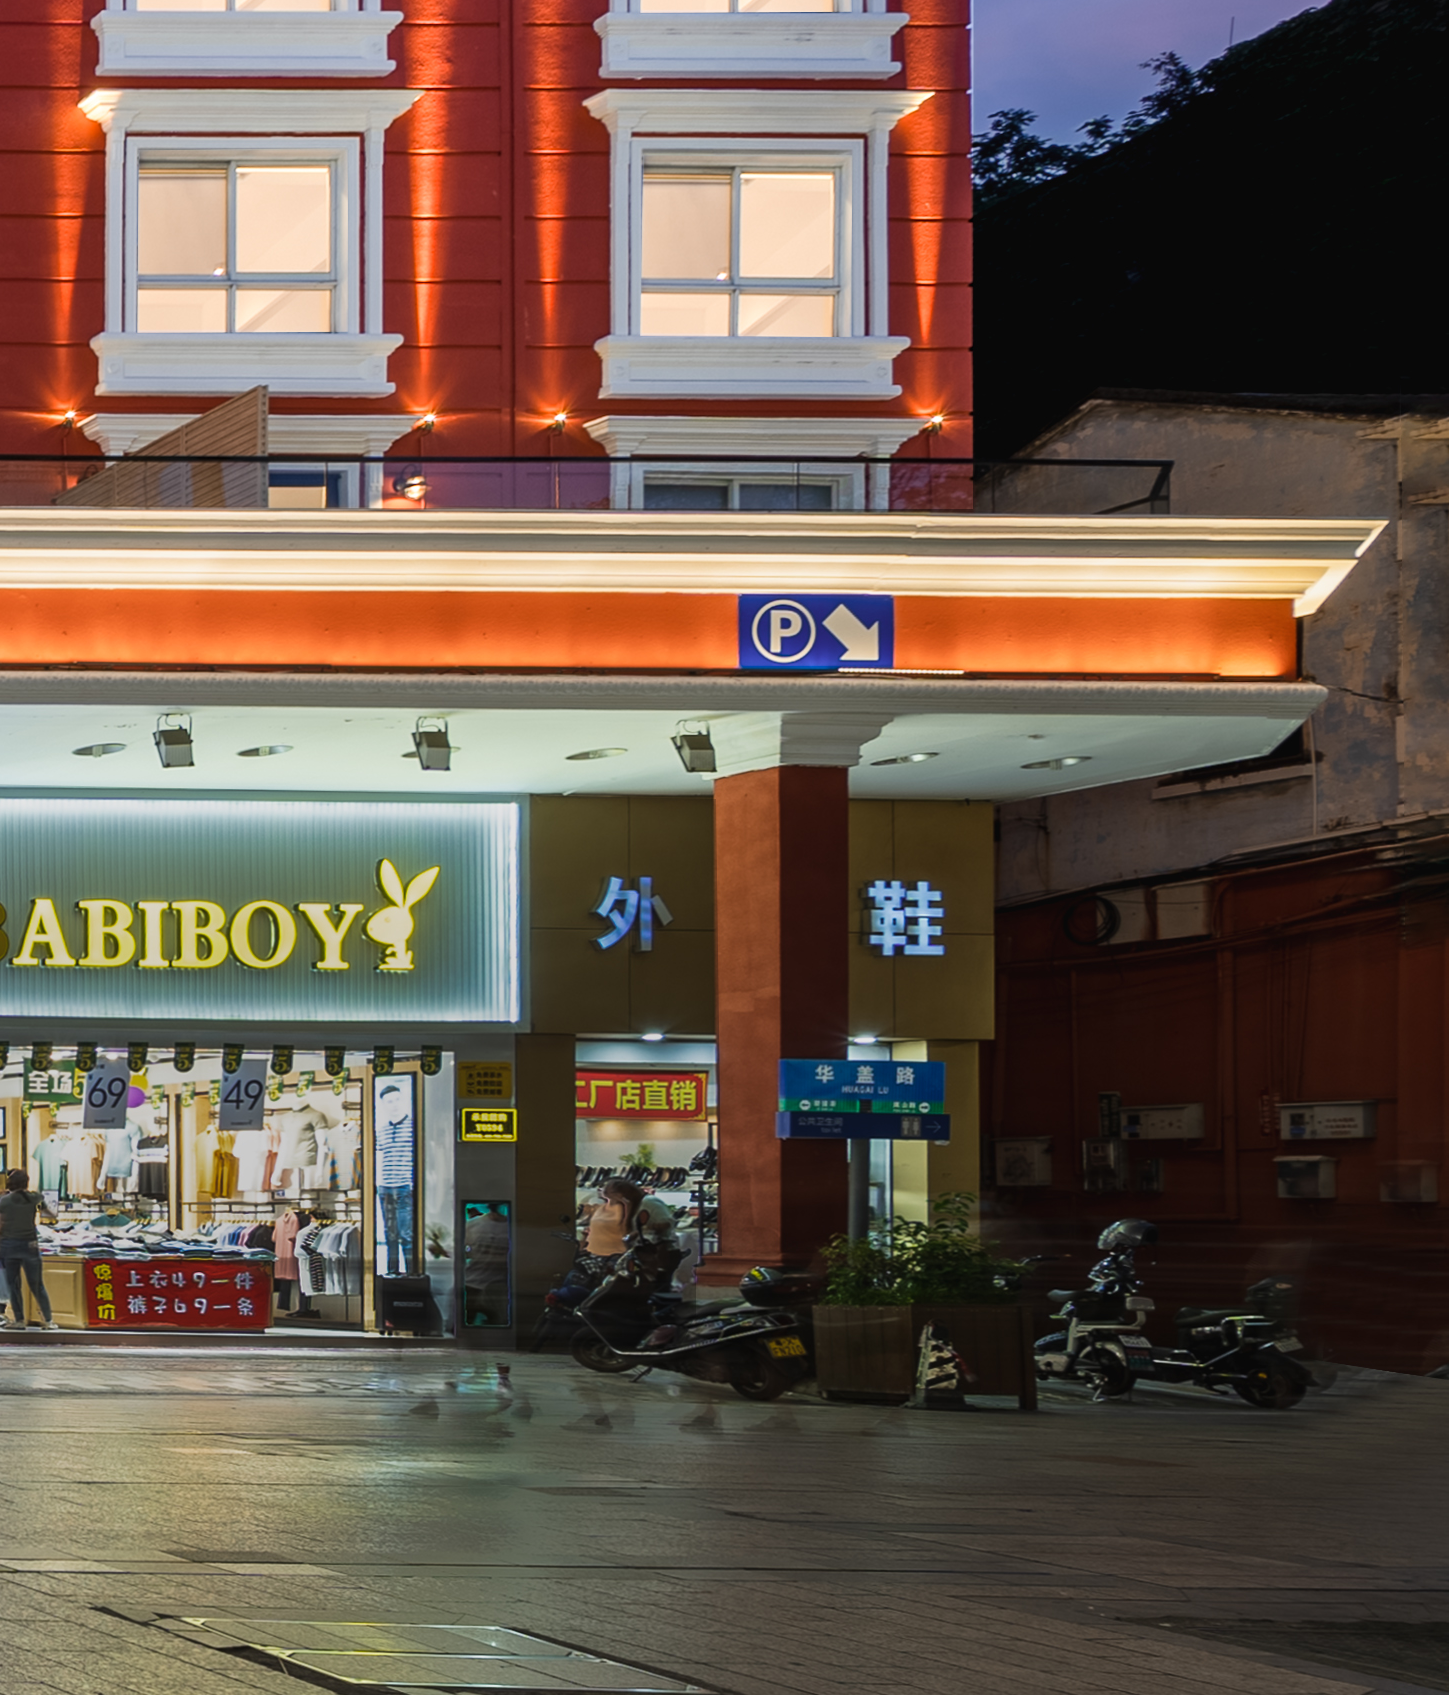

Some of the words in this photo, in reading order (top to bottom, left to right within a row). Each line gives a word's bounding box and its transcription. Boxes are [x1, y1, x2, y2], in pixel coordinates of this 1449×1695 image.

[769, 609, 803, 654] P
[815, 1064, 915, 1086] 华盖路
[88, 1076, 127, 1109] 69
[223, 1078, 264, 1111] 49
